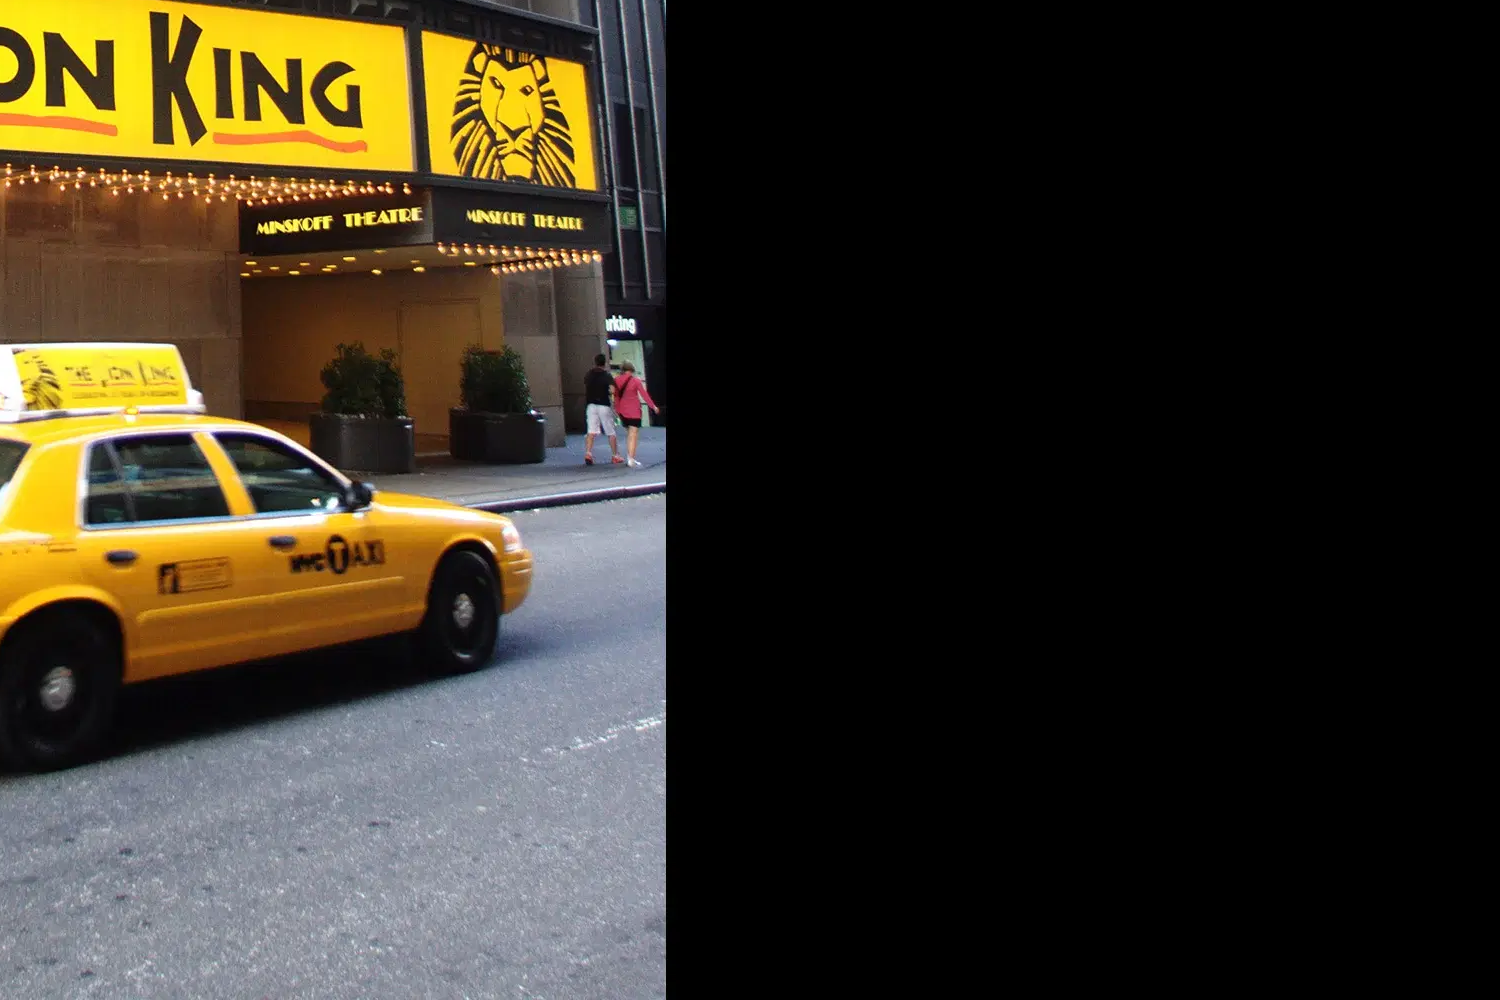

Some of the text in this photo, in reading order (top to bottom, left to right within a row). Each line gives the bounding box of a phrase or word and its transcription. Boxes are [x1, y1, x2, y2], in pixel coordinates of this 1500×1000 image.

[149, 11, 364, 146] KING
[256, 207, 424, 236] MINSKOFF THEATRE
[466, 209, 584, 231] MINSKOFF THEATRE
